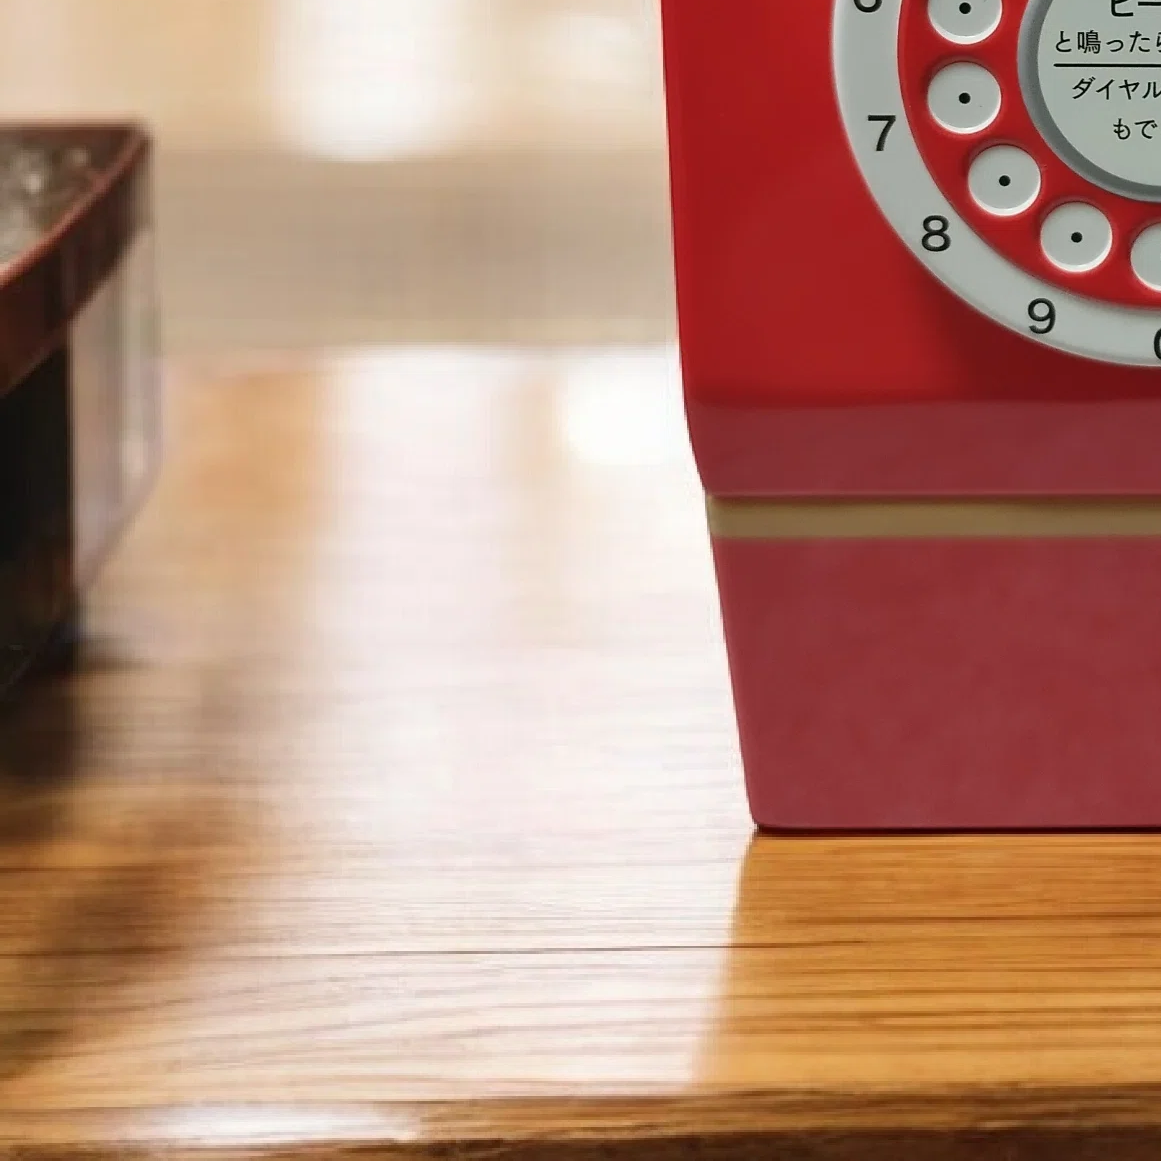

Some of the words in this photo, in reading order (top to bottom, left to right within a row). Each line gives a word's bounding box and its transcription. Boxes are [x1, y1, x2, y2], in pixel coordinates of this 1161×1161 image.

[867, 114, 898, 152] 7
[921, 214, 952, 253] 8
[1027, 297, 1057, 335] 9
